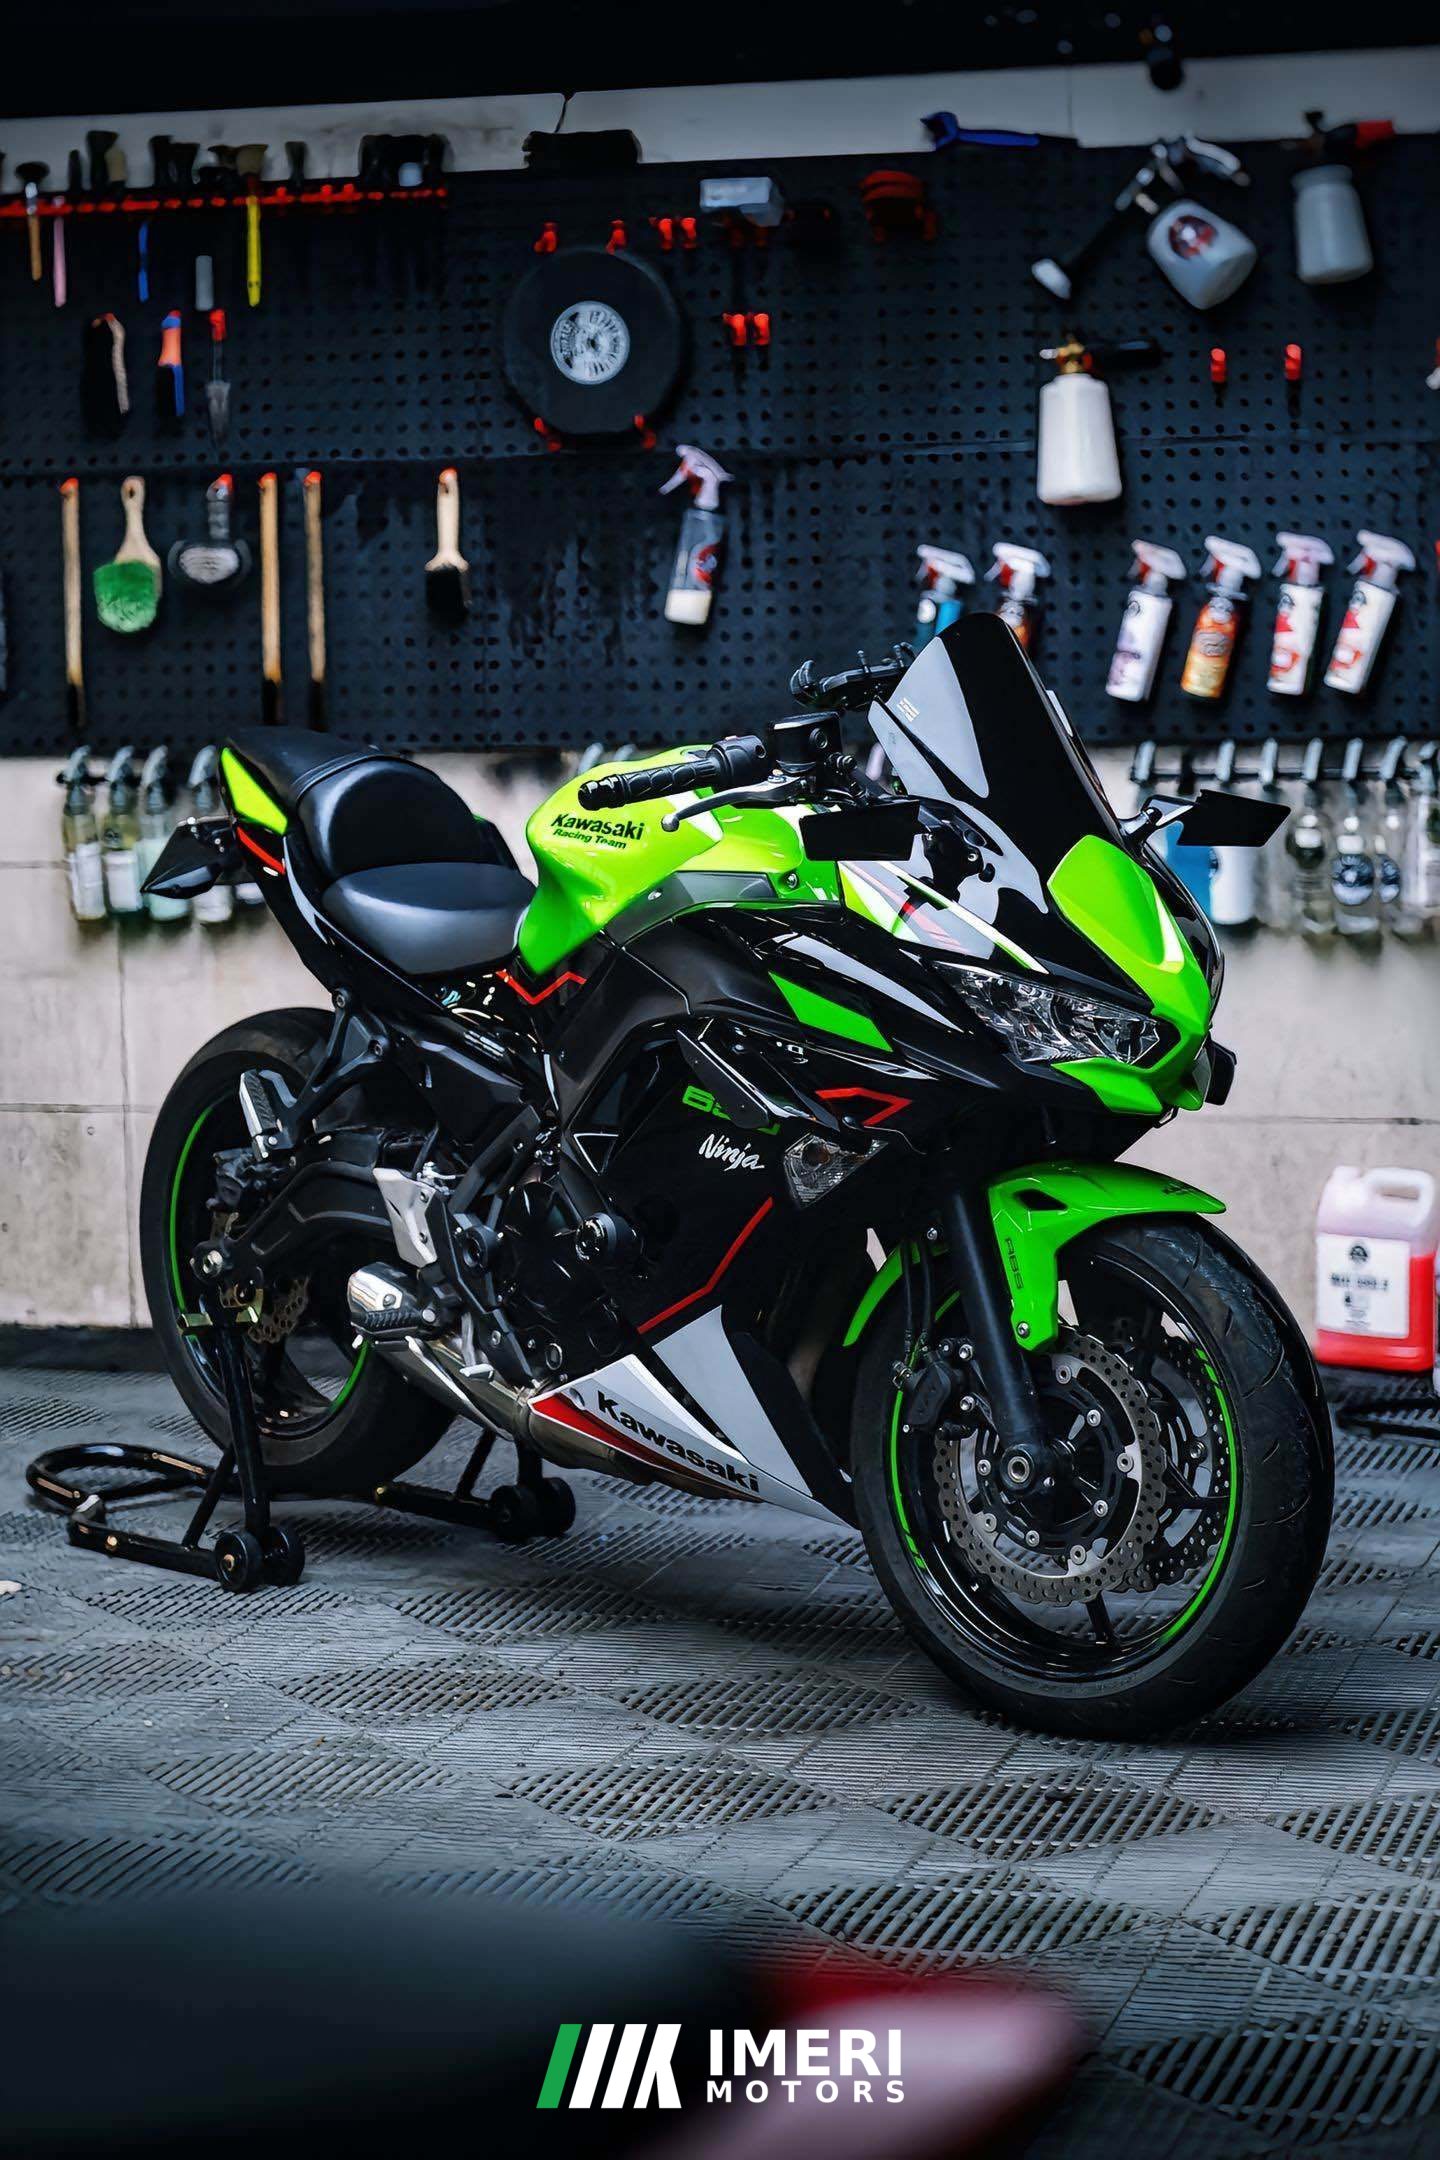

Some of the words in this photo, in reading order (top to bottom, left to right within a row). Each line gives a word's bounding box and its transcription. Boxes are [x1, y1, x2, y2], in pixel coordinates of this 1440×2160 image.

[550, 813, 645, 840] Kawasaki
[553, 828, 593, 844] Racing
[595, 834, 627, 849] Team
[698, 1133, 765, 1172] Ninja
[1005, 1236, 1024, 1290] ABS
[597, 1389, 760, 1493] Kawasaki
